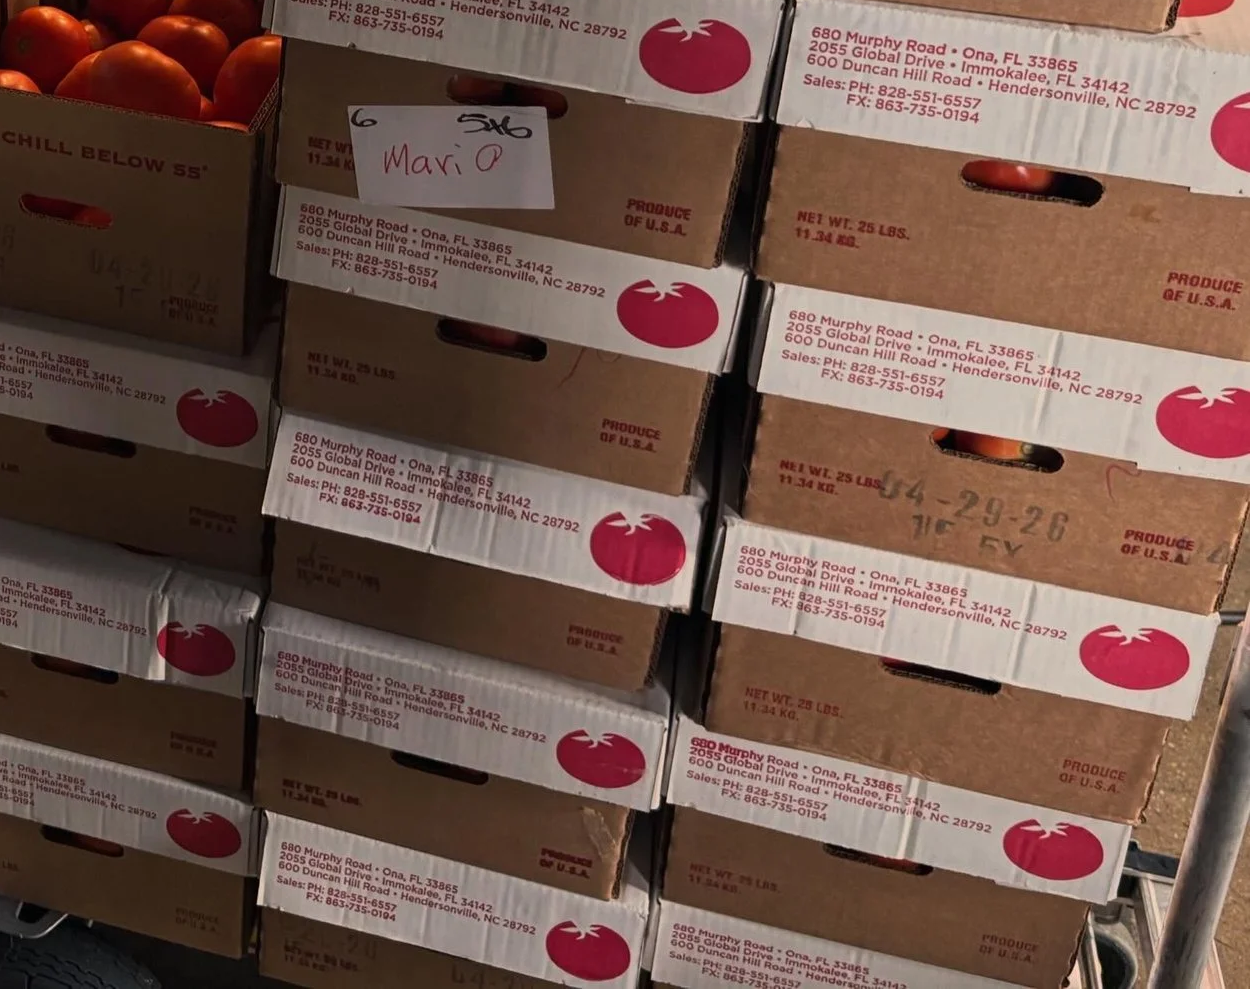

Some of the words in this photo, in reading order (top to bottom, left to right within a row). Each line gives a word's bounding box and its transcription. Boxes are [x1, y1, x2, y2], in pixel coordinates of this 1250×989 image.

[350, 108, 377, 127] 6
[2, 131, 72, 156] CHILL
[81, 146, 166, 173] BELOW
[624, 214, 642, 227] OF
[626, 198, 692, 221] PRODUCE
[300, 202, 324, 215] 680
[327, 207, 373, 227] Murphy
[376, 218, 408, 233] Road
[420, 228, 449, 243] Ona,
[453, 234, 469, 246] FL
[472, 238, 512, 255] 33865
[797, 211, 822, 225] NET
[829, 216, 852, 230] WT.
[857, 221, 874, 234] 25
[878, 225, 910, 240] LBS.
[298, 213, 329, 227] 2055
[333, 221, 372, 237] Global
[375, 229, 408, 244] Drive
[420, 238, 491, 263] Immokalee,
[495, 254, 511, 266] FL
[514, 258, 553, 275] 34142
[297, 223, 322, 237] 600
[326, 230, 371, 248] Duncan
[374, 240, 394, 253] Hill
[397, 245, 429, 260] Road
[442, 254, 538, 284] Hendersonville,
[542, 275, 562, 287] NC
[564, 280, 606, 298] 28792
[1167, 272, 1243, 294] PRODUCE
[1162, 289, 1184, 301] OF
[1187, 293, 1235, 310] U.S.A.
[878, 469, 1068, 543] 04-29-26
[1120, 543, 1141, 555] OF
[1124, 529, 1195, 551] PRODUCE
[0, 576, 23, 589] Ona,
[26, 581, 39, 592] FL
[41, 585, 72, 599] 33865
[685, 770, 720, 785] Sales:
[722, 778, 743, 791] PH:
[1059, 772, 1078, 783] OF
[1062, 759, 1127, 781] PRODUCE
[720, 788, 740, 800] FX:
